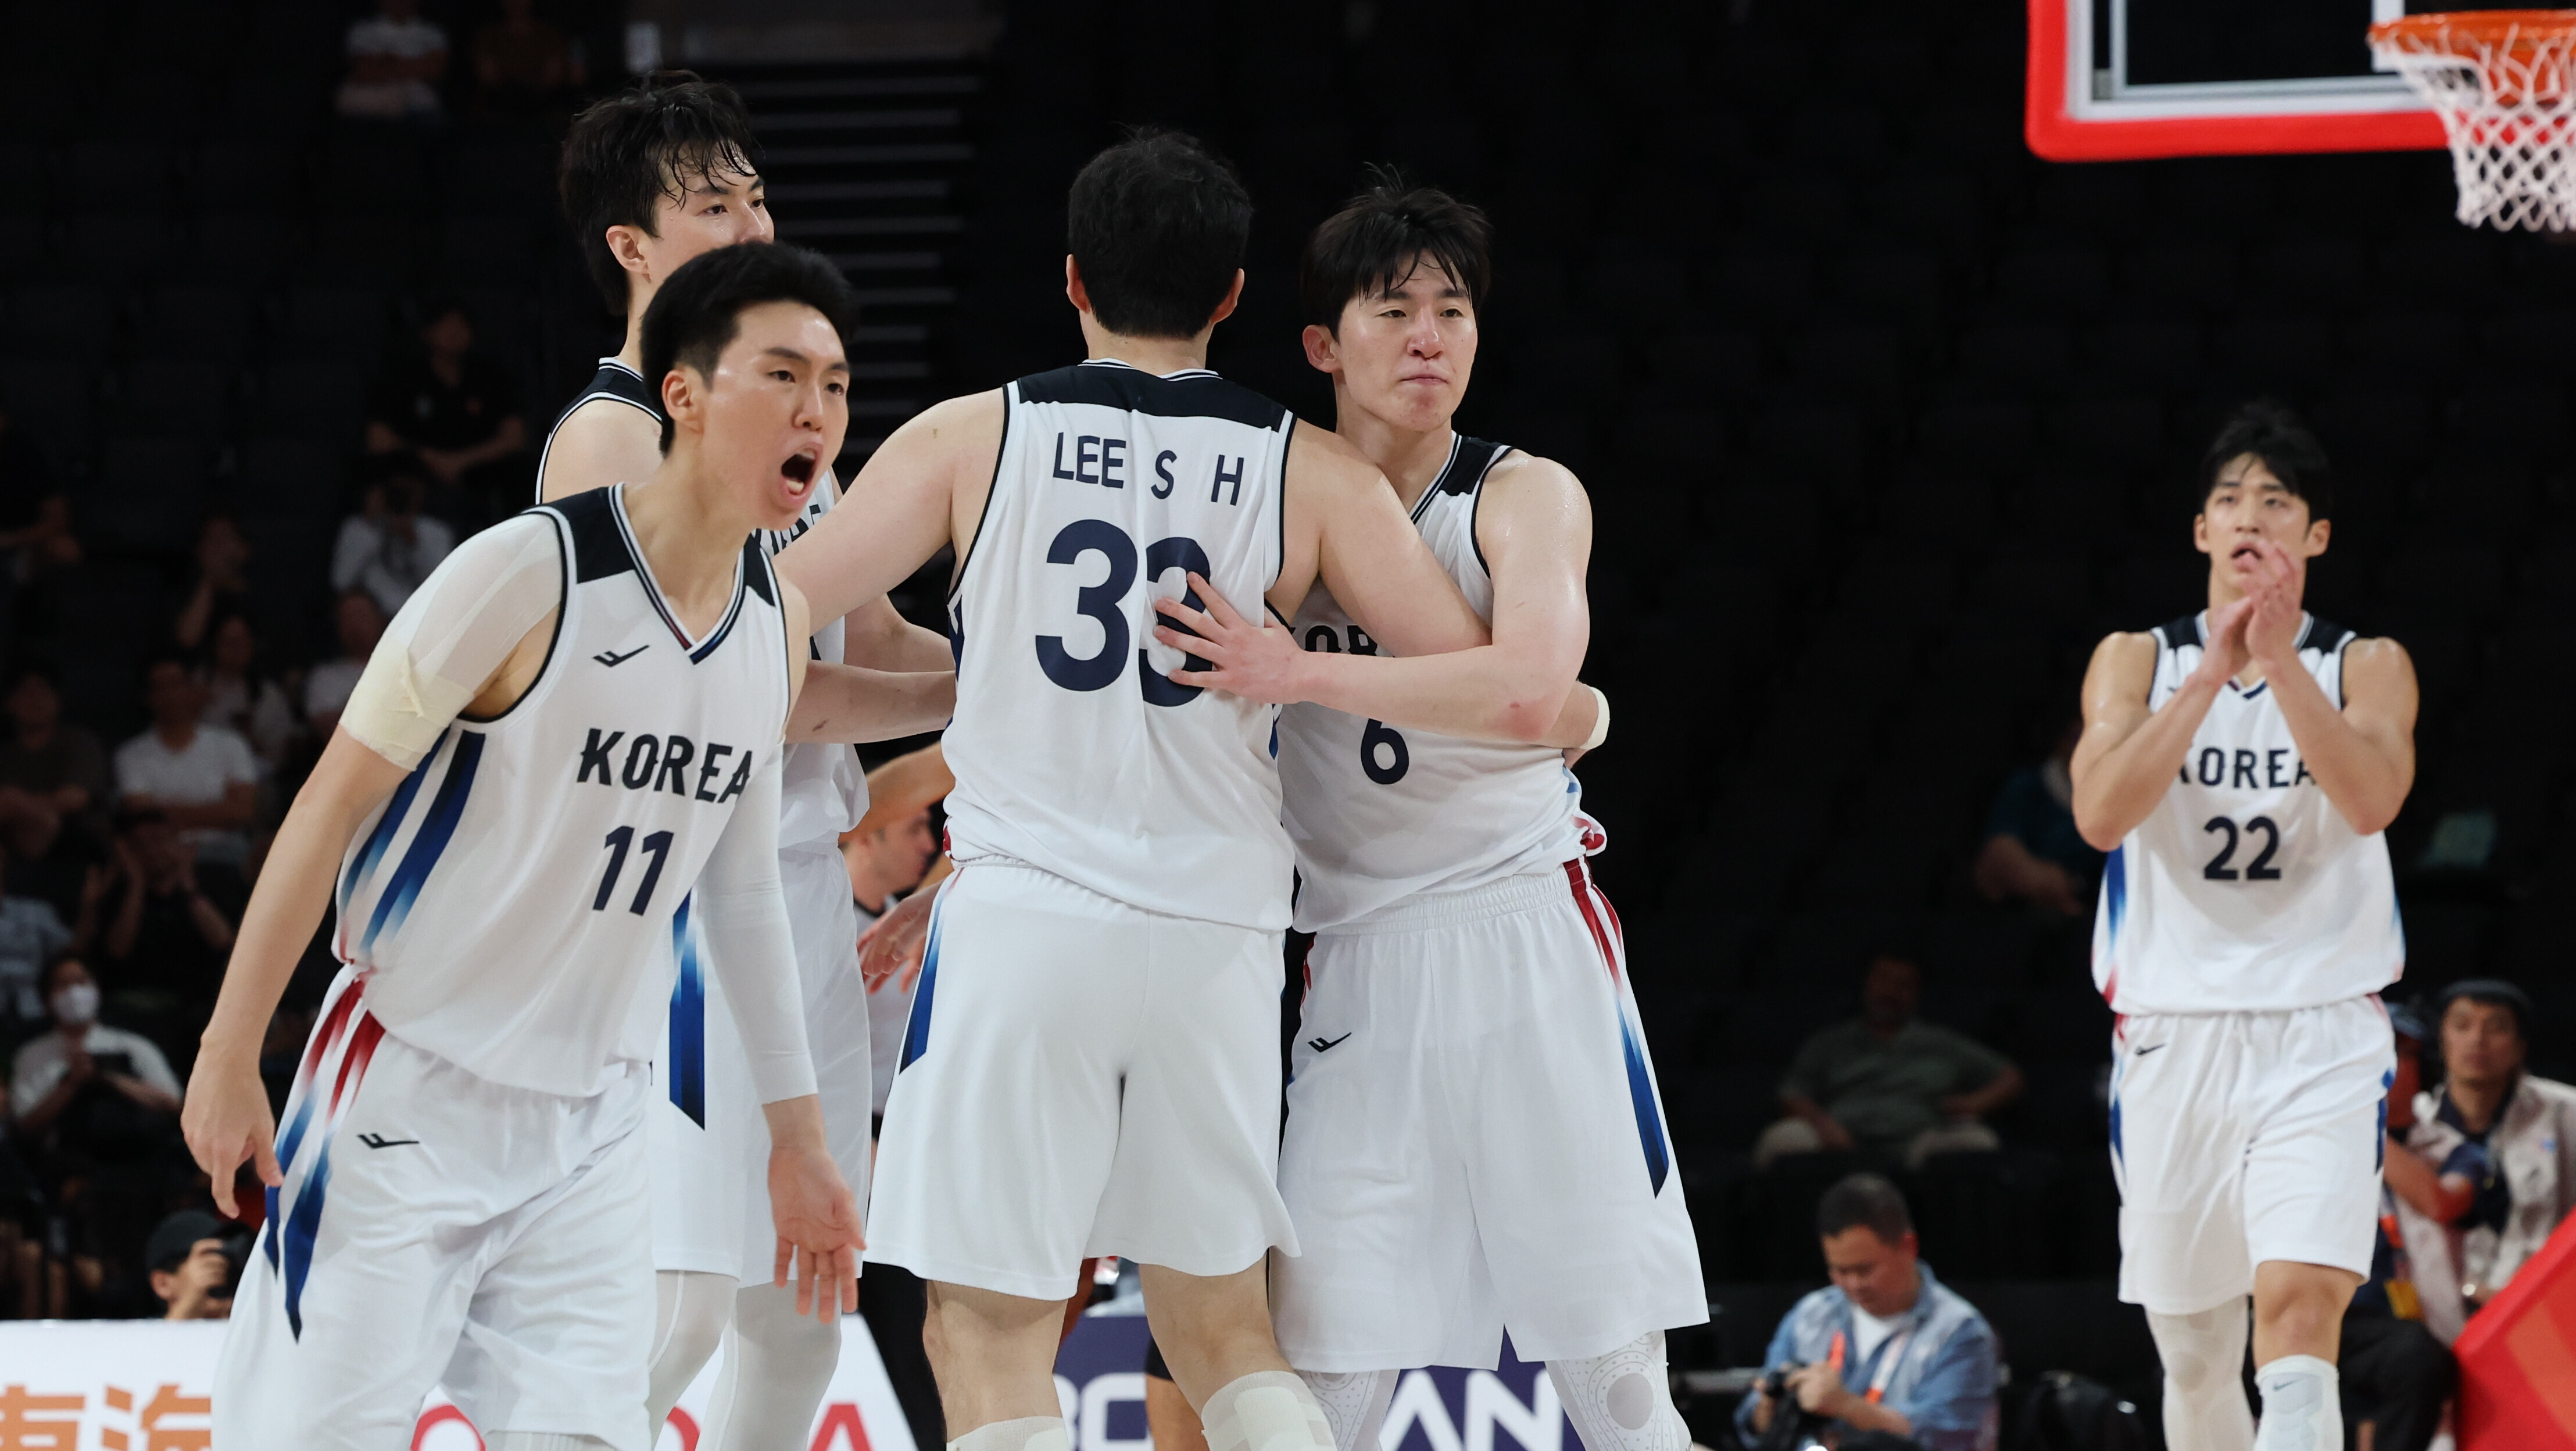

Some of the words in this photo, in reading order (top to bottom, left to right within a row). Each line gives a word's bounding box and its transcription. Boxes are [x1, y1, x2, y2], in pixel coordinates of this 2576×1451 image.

[1053, 432, 1126, 489] LEE
[1150, 450, 1178, 499] S
[1211, 454, 1244, 506] H
[1035, 519, 1212, 707] 33
[577, 728, 753, 803] KOREA
[1360, 717, 1410, 785] 6
[592, 825, 675, 916] 11
[2203, 816, 2282, 881] 22
